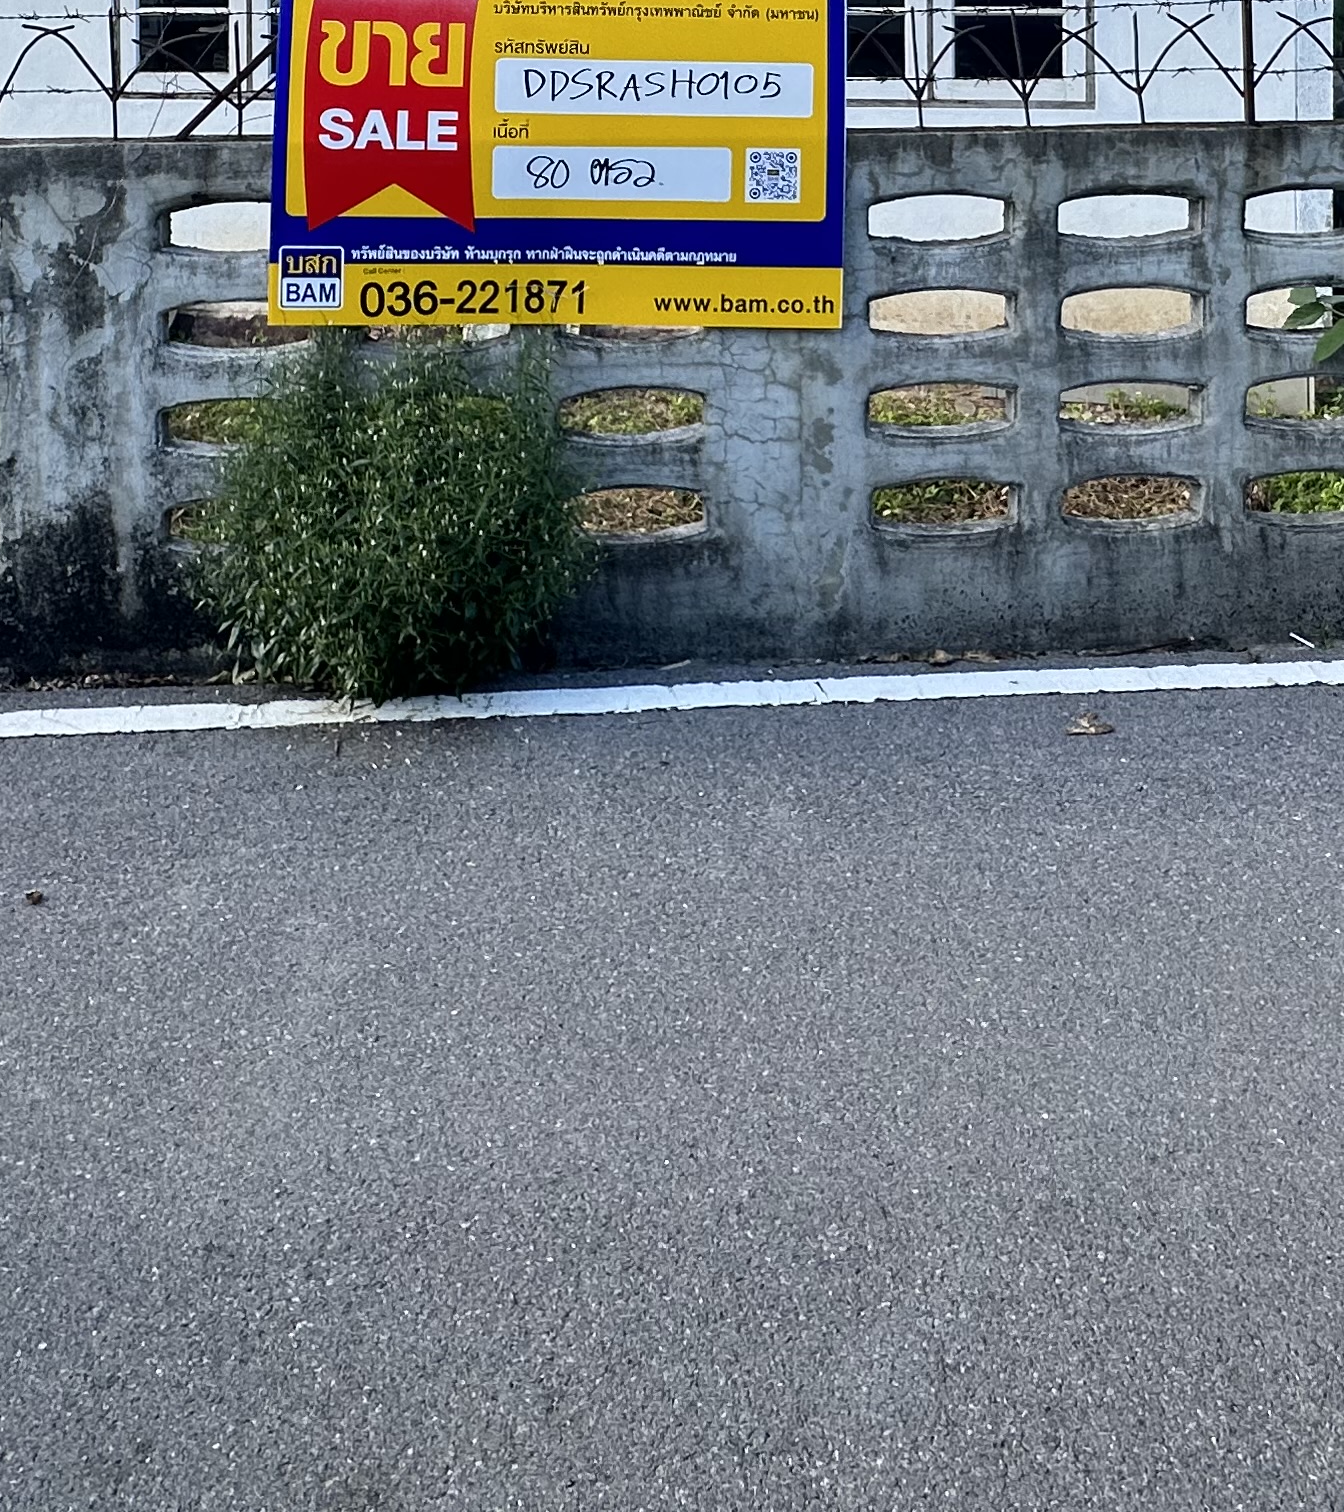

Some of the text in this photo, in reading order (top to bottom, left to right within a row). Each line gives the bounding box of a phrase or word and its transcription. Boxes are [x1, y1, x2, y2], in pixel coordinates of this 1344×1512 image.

[727, 3, 760, 19] จำกัด
[766, 7, 819, 22] (มหาชน)
[319, 19, 466, 87] ขาย
[494, 38, 590, 55] รหัสทรัพย์สิน
[318, 108, 459, 151] SALE
[492, 120, 531, 140] เนื้อที่
[526, 155, 570, 189] 80
[286, 254, 337, 275] บสก
[351, 244, 460, 261] ทรัพย์สินของบริษัท
[464, 245, 521, 264] ห้ามบุกรุก
[286, 283, 337, 303] BAM
[360, 279, 586, 318] 036-221871
[654, 292, 835, 316] www.bam.co.th
